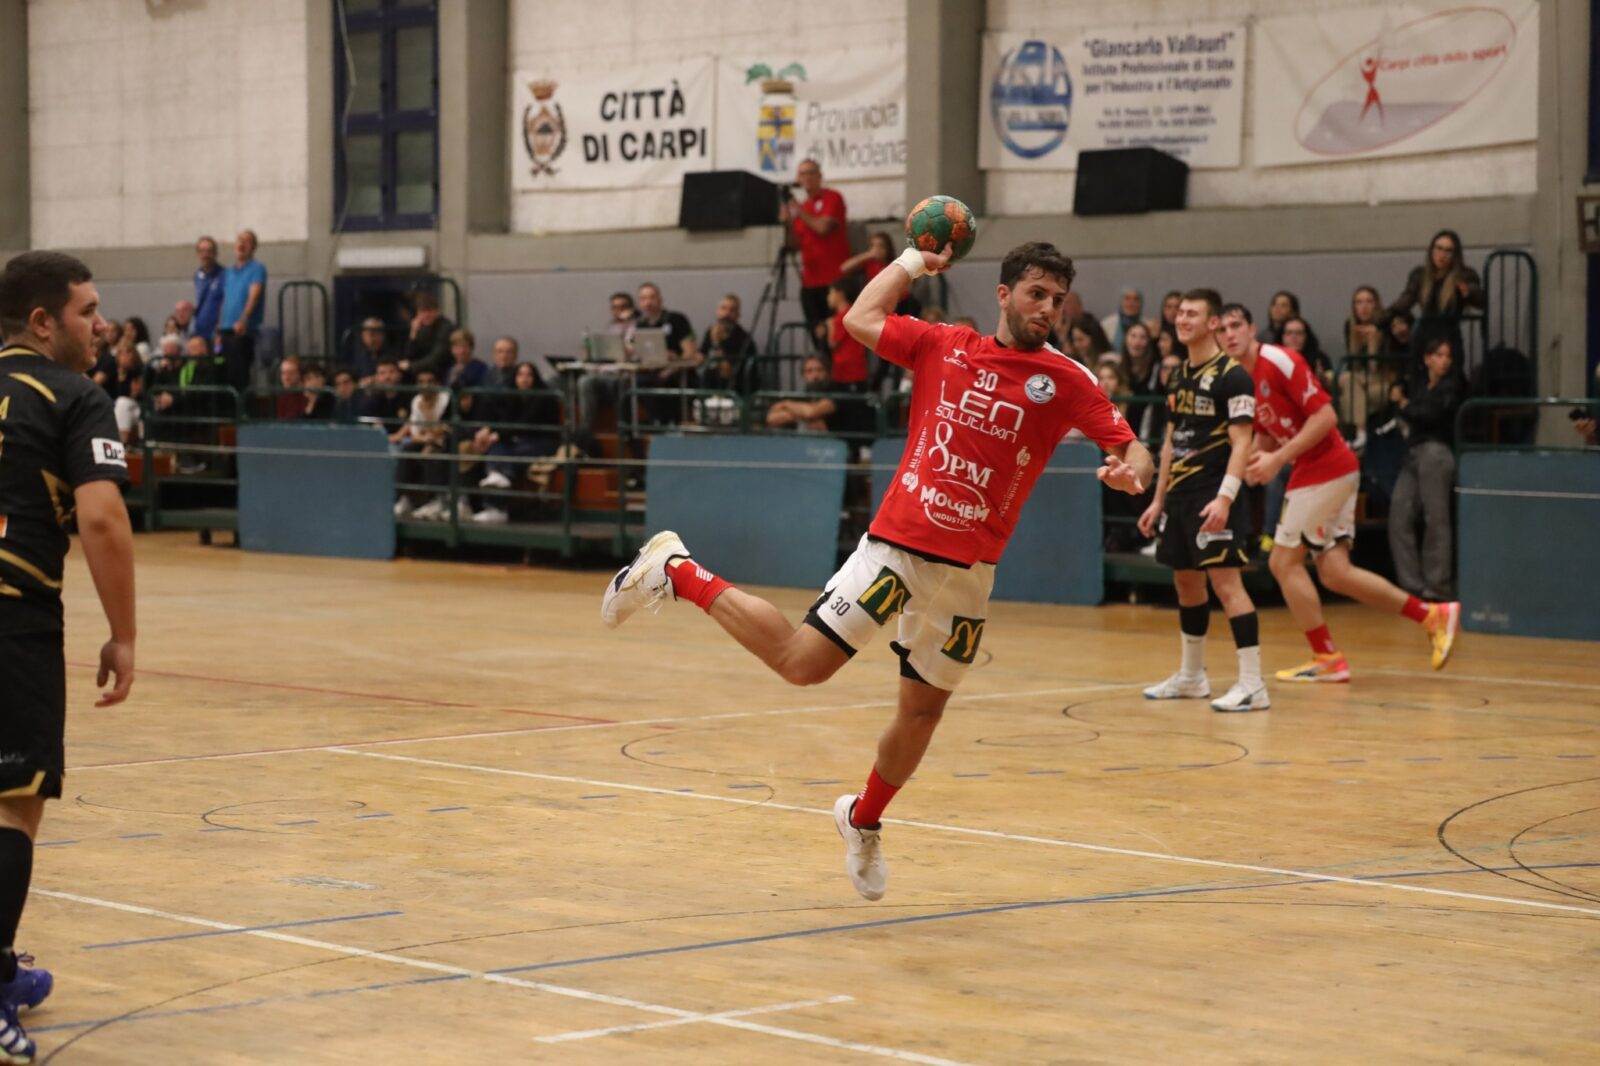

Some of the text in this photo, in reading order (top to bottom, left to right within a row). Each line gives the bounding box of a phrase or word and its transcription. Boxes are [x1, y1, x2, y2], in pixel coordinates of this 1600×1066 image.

[601, 79, 685, 121] CITTÀ
[805, 101, 899, 132] Provincia
[583, 128, 706, 163] DI CARPI
[827, 138, 908, 168] Modena
[973, 369, 999, 391] 30
[830, 596, 851, 616] 30
